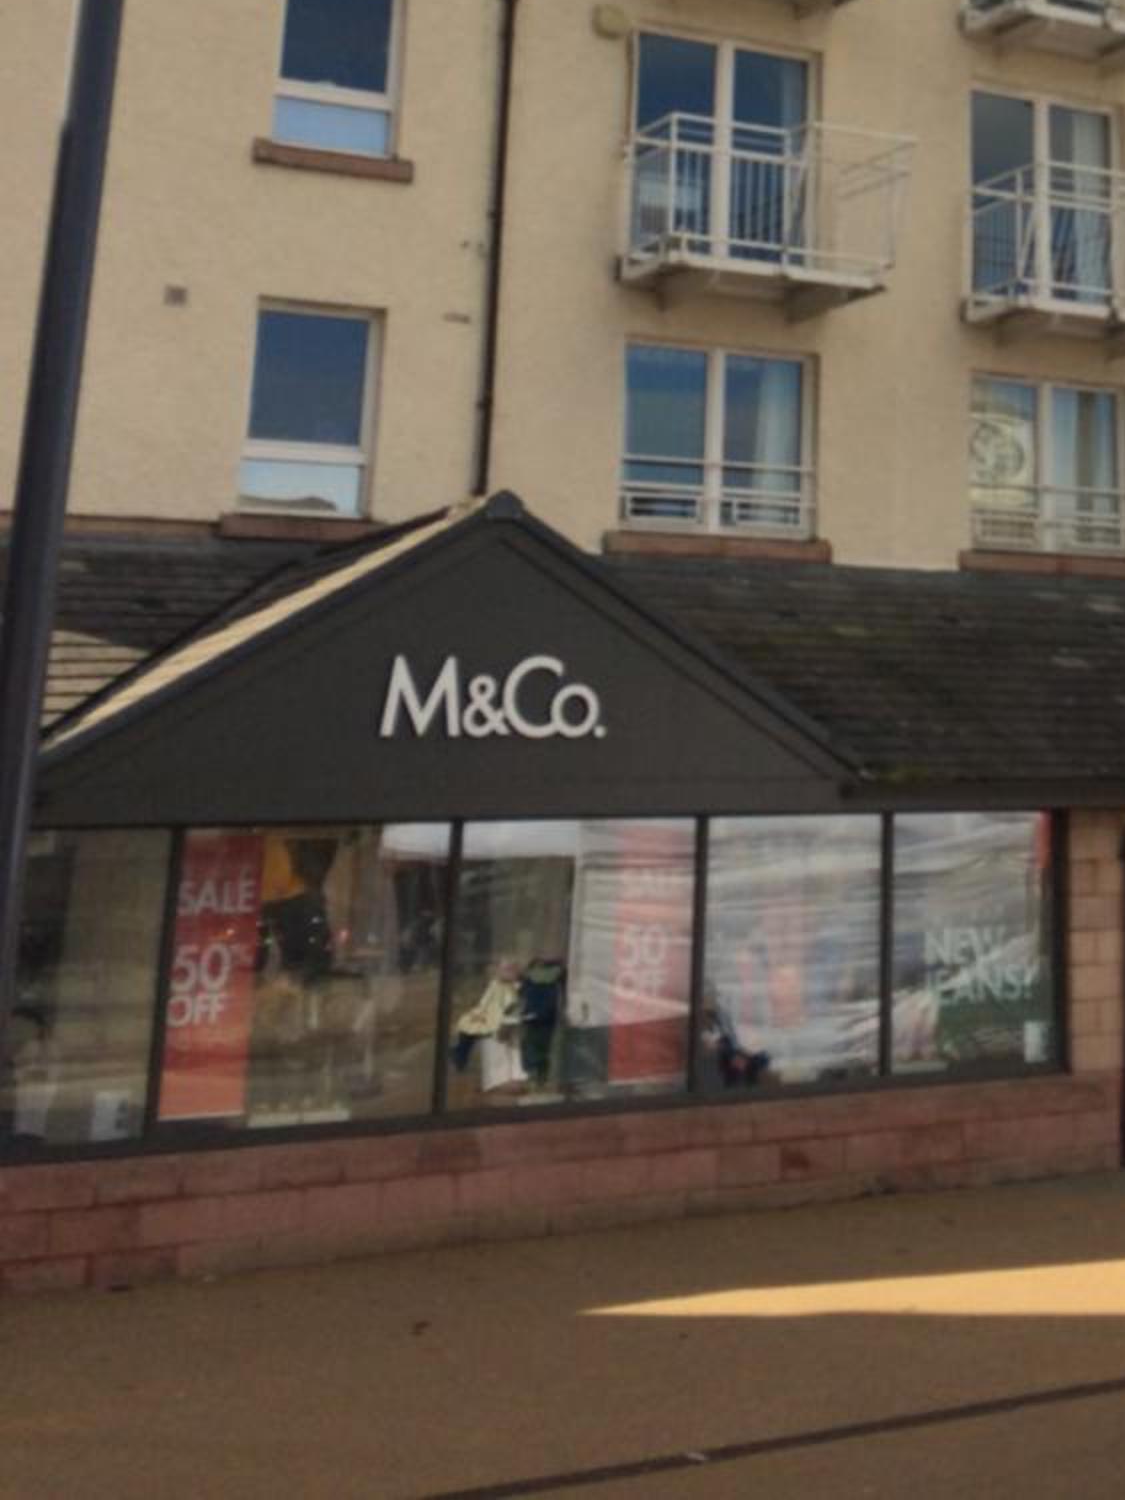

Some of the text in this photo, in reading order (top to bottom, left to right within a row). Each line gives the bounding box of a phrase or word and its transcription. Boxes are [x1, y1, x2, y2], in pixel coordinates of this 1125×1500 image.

[379, 654, 607, 739] M&Co.
[177, 879, 256, 916] SALE
[165, 994, 225, 1028] OFF
